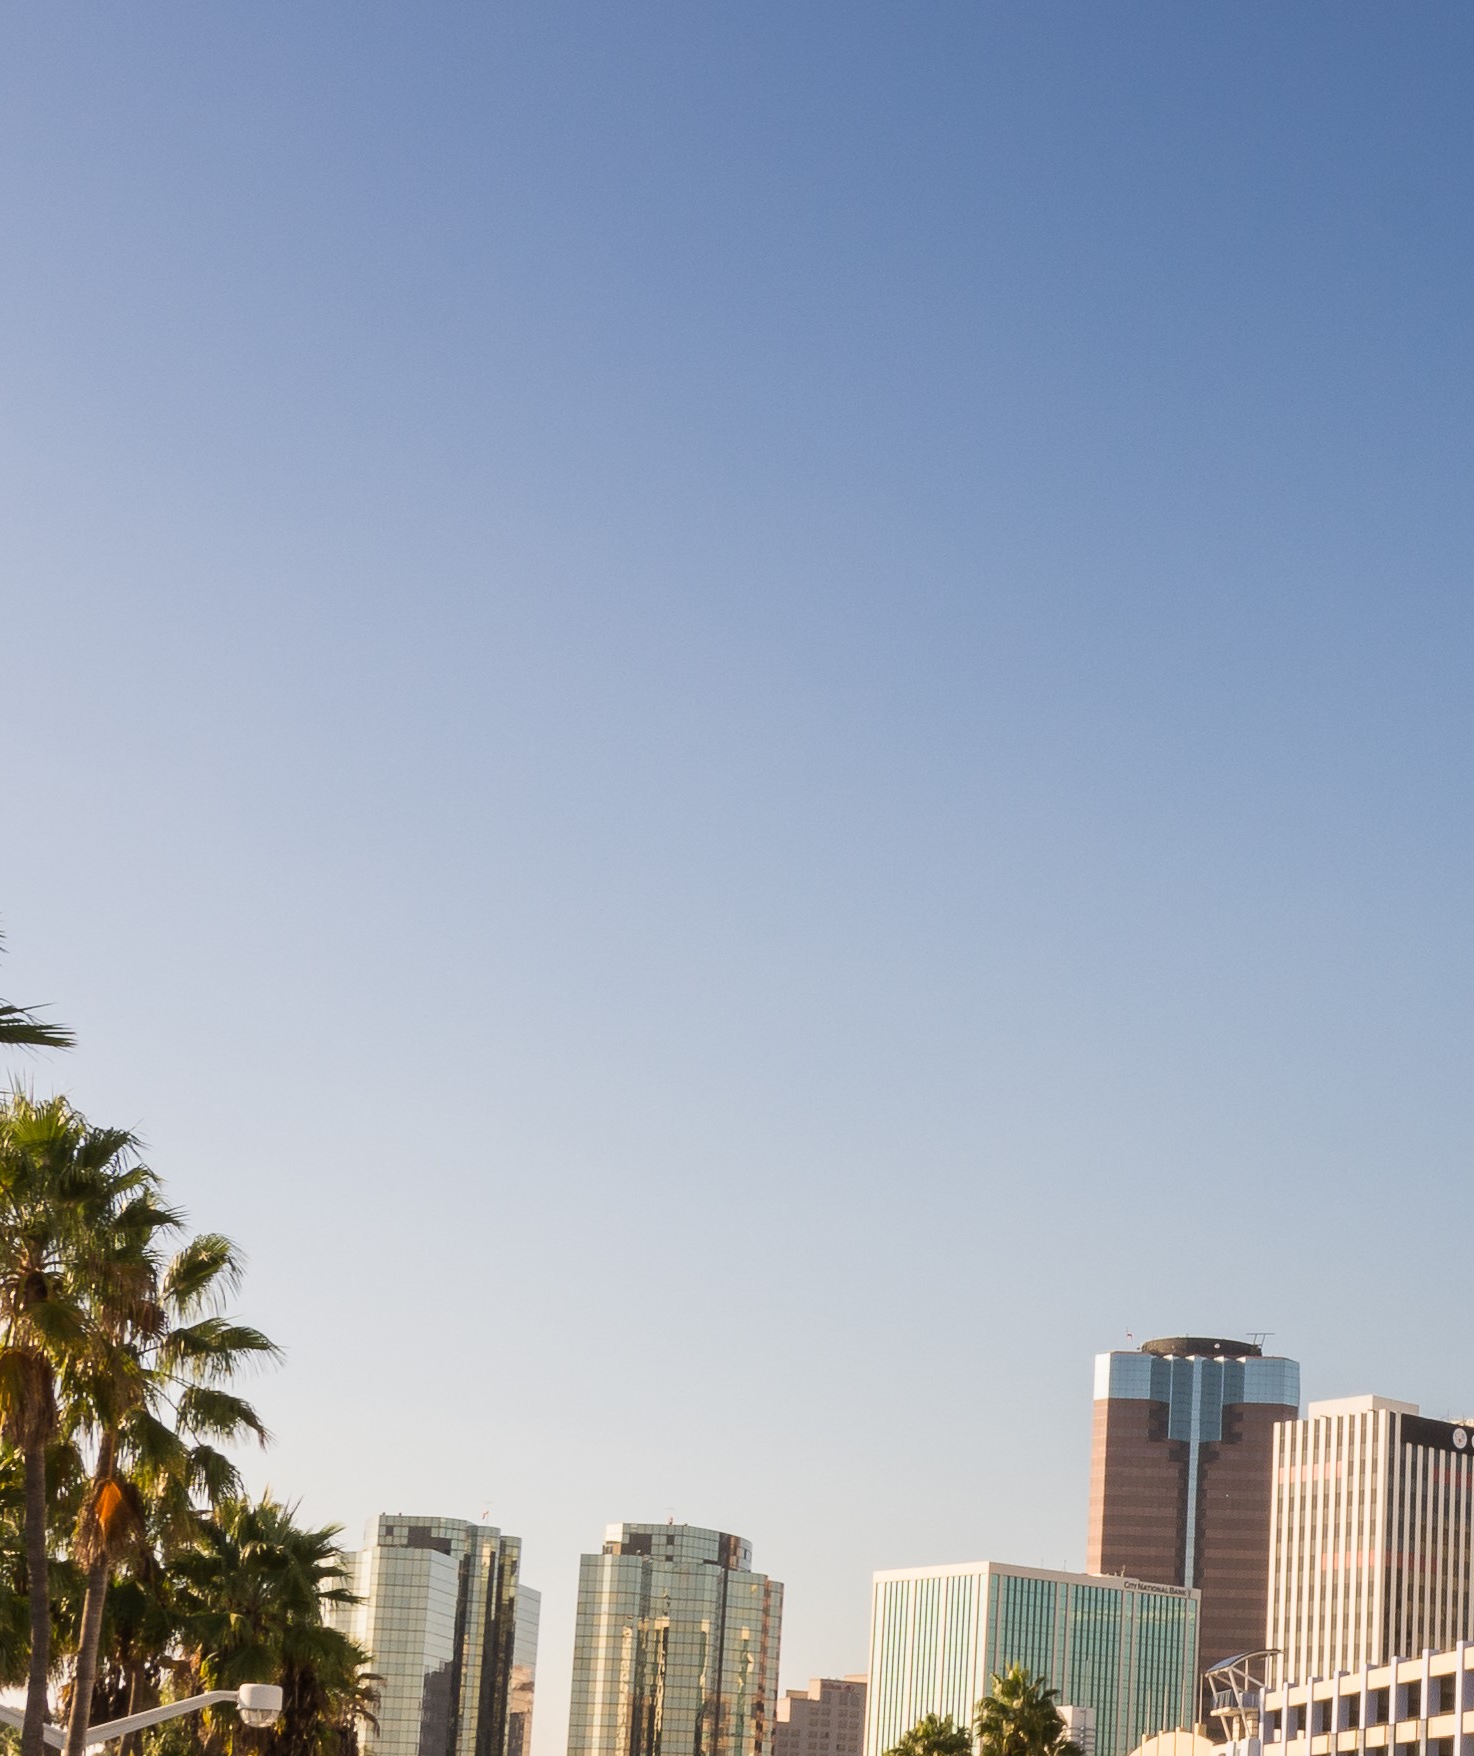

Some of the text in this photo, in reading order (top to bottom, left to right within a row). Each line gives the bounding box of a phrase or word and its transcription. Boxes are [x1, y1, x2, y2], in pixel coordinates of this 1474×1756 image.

[1123, 1580, 1186, 1596] CITY NATIONAL BANK
